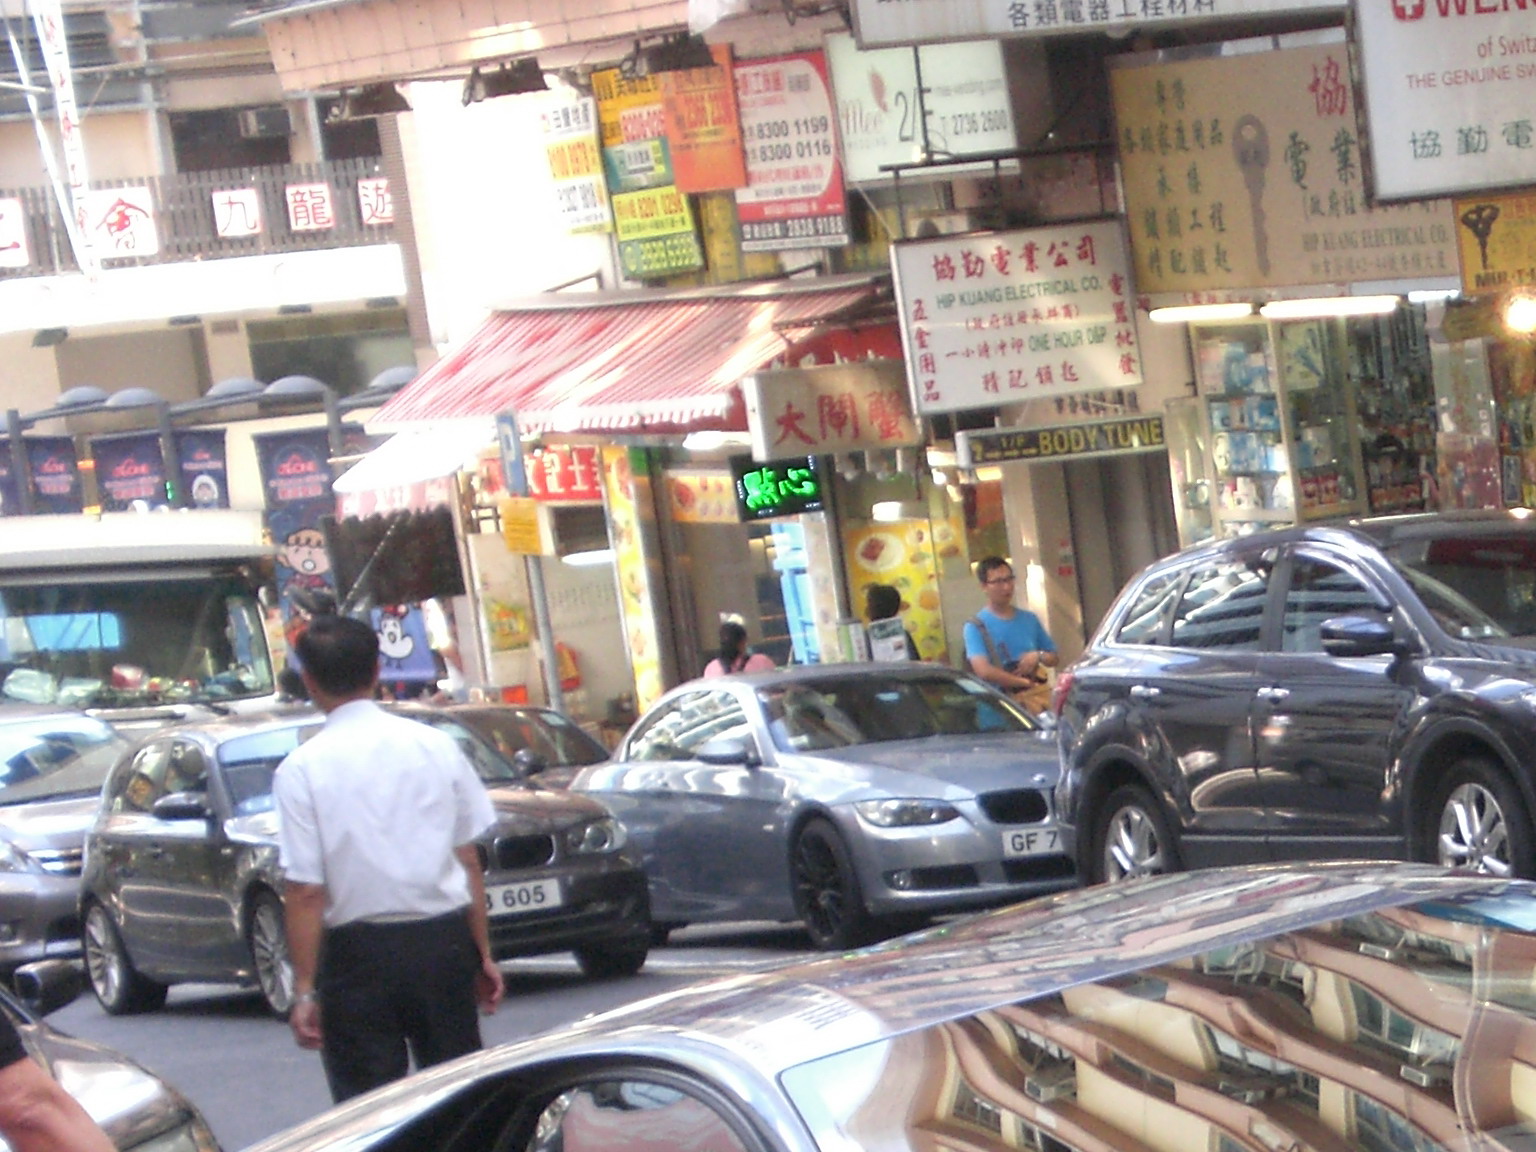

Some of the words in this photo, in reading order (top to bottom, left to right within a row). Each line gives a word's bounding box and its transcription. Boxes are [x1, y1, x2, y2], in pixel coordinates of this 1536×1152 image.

[1477, 36, 1493, 58] of
[1407, 72, 1437, 89] THE
[1442, 66, 1511, 86] GENUINE
[933, 235, 1097, 281] 協勤電業公司
[936, 293, 956, 310] HIP
[959, 287, 1003, 306] KUANG
[1005, 279, 1078, 302] ELECTRICAL
[1081, 275, 1103, 291] CO.
[913, 298, 941, 402] 五金用品
[1028, 334, 1051, 352] ONE
[1054, 330, 1083, 347] HOUR
[774, 391, 904, 446] 大閘蟹
[1038, 427, 1098, 455] BODY
[1103, 418, 1163, 448] TUNE
[743, 467, 817, 511] 點心
[1011, 832, 1038, 852] GF
[1046, 831, 1058, 849] 7
[502, 885, 546, 908] 605
